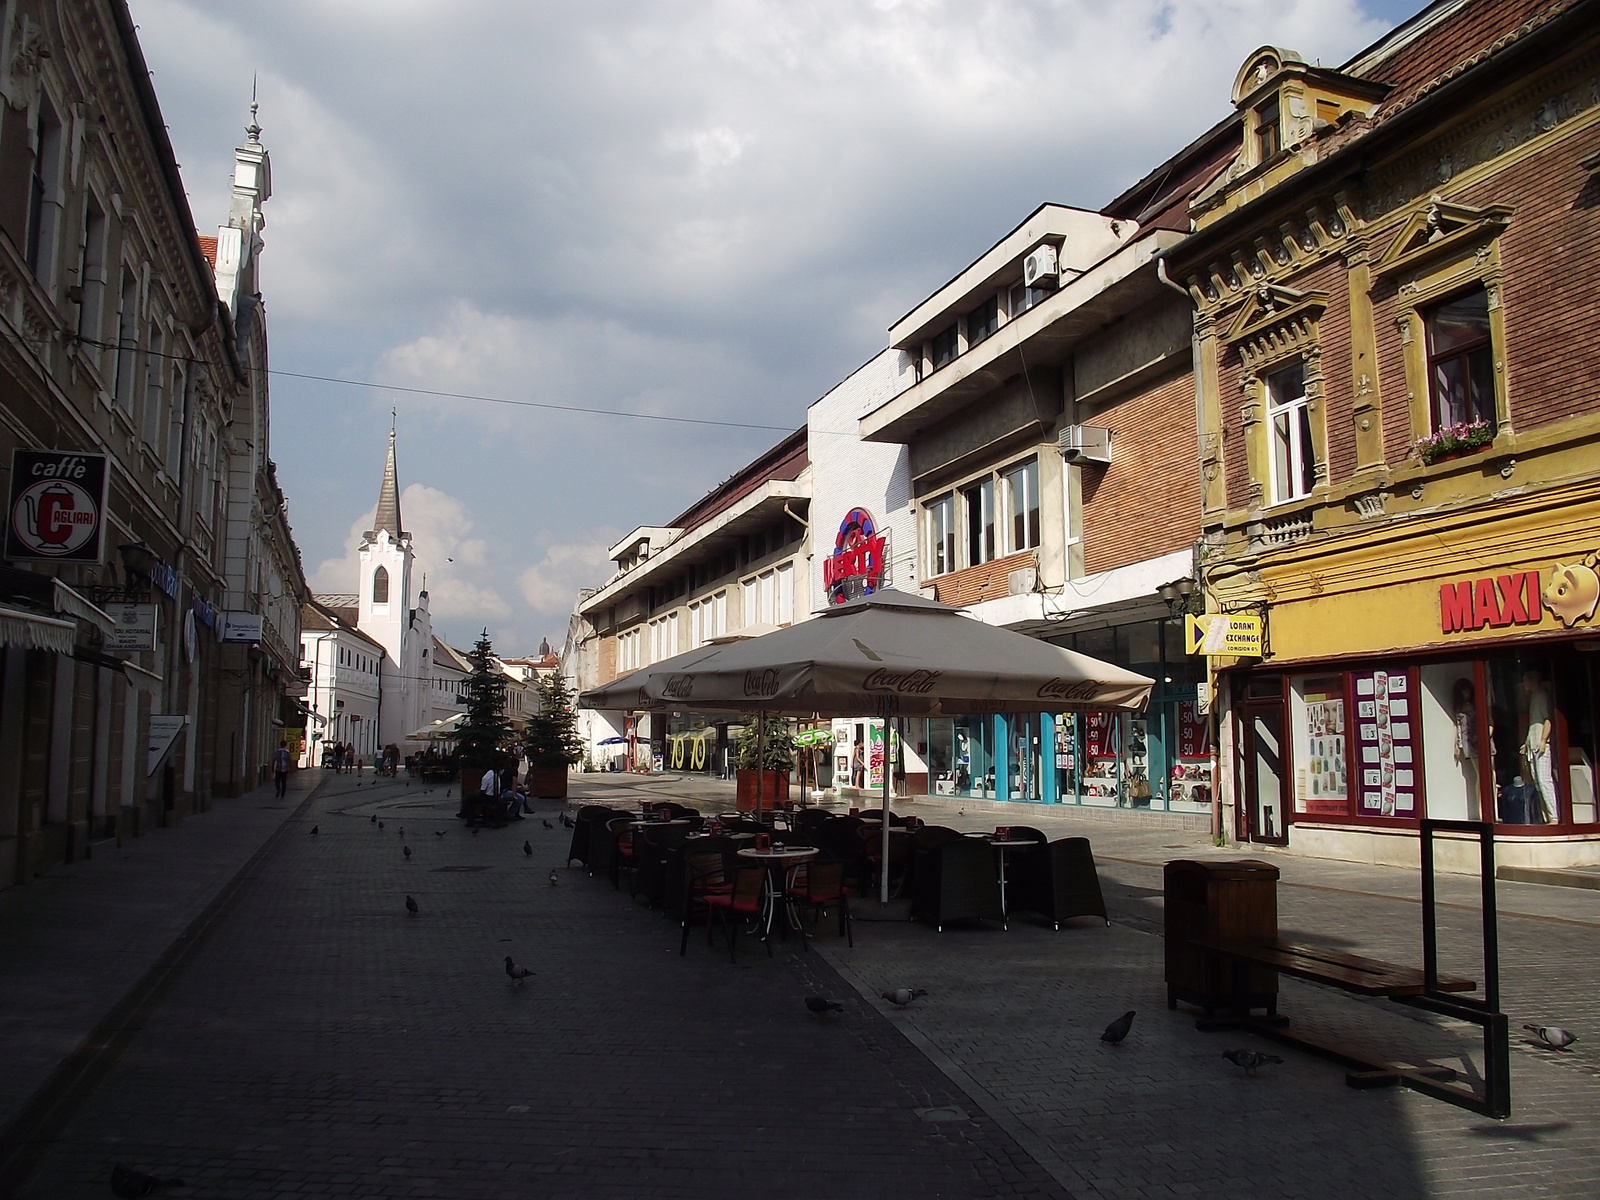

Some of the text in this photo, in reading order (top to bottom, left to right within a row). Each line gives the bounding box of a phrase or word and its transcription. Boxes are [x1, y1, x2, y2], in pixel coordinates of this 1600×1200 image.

[31, 456, 87, 479] caffè
[37, 493, 94, 544] CAGLIARI
[1440, 571, 1542, 634] MAXI
[1229, 622, 1255, 631] LORANT
[1226, 634, 1260, 643] EXCHANGE
